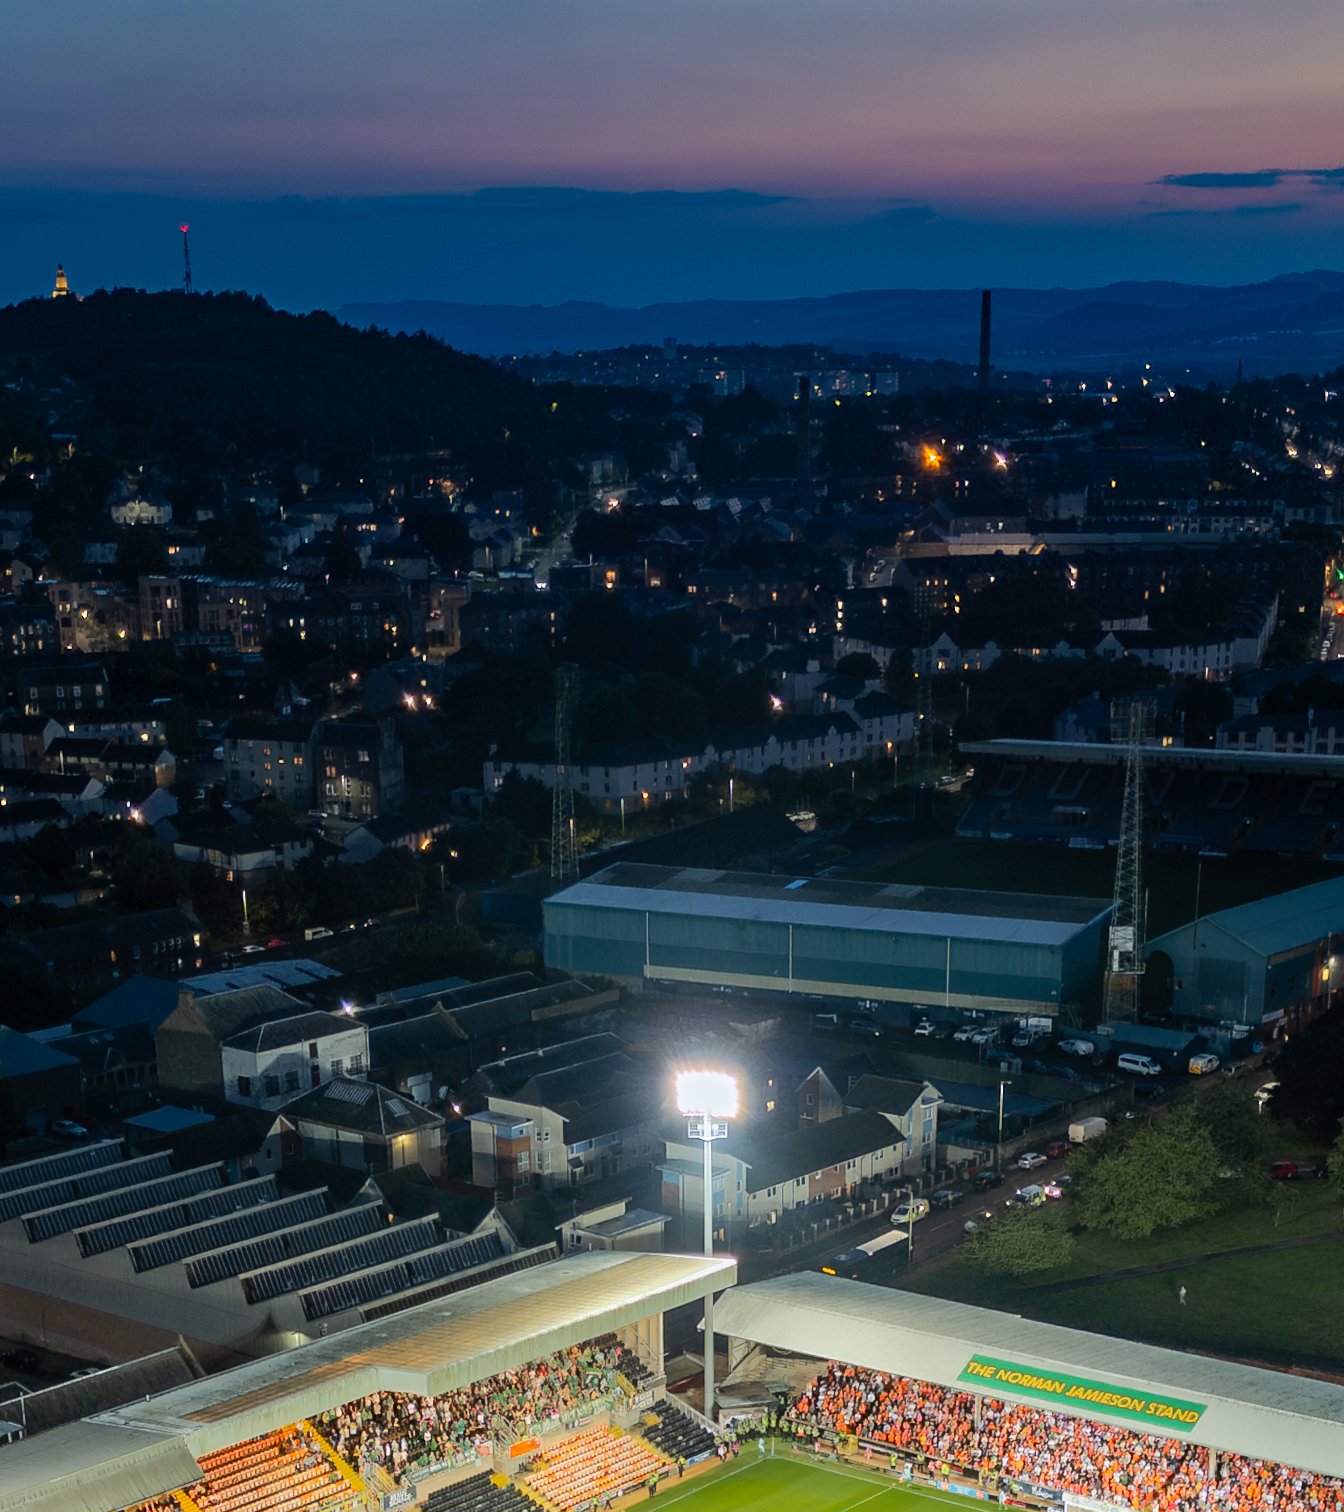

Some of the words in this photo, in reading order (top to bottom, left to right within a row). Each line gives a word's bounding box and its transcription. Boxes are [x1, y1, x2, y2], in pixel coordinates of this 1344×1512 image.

[966, 1361, 996, 1379] THE
[996, 1368, 1066, 1396] NORMAN
[1065, 1384, 1146, 1412] JAMIESON
[1145, 1402, 1200, 1424] STAND
